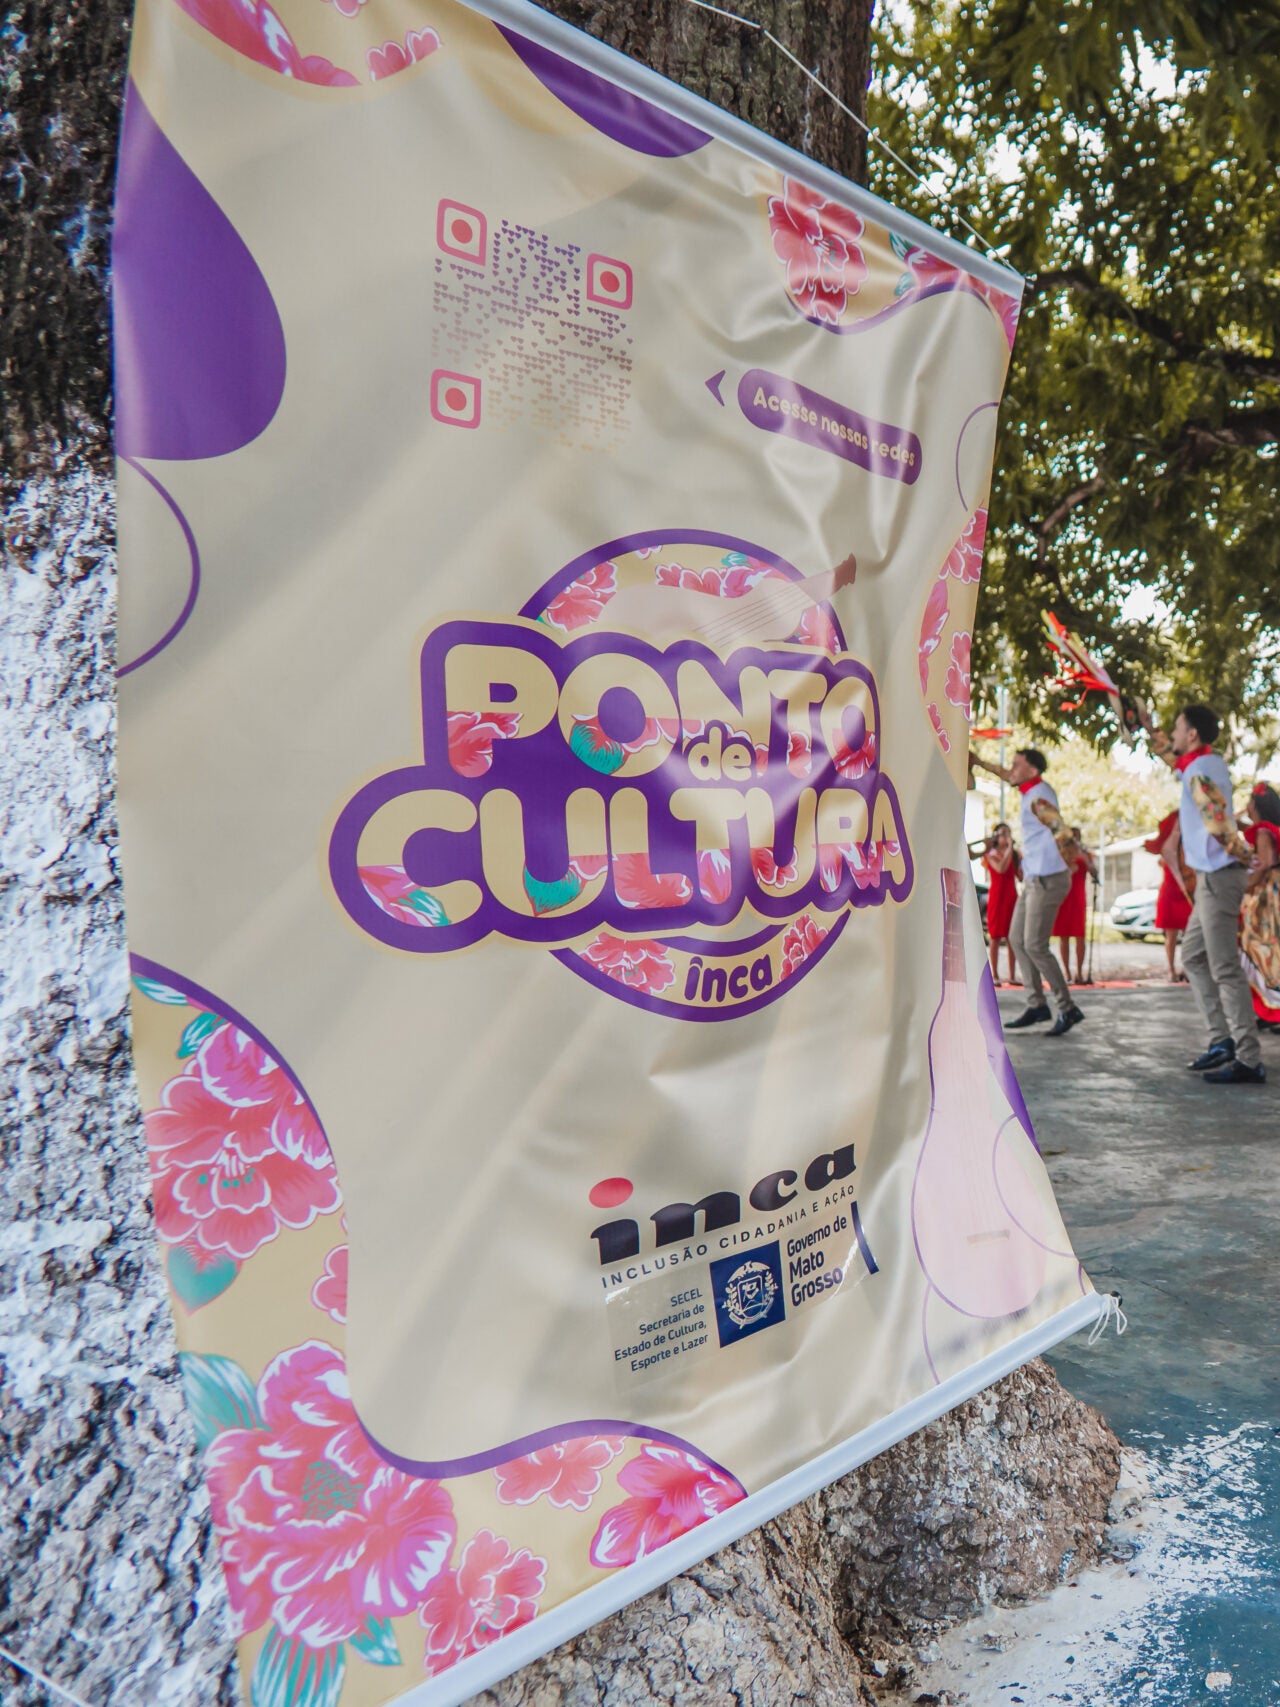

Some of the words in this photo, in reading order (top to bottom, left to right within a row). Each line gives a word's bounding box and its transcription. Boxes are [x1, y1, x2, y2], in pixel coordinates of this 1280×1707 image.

[753, 387, 818, 426] Acesse
[821, 415, 868, 451] nossas
[870, 441, 915, 467] redes
[444, 643, 878, 780] PONTO
[687, 726, 753, 781] de
[356, 786, 908, 928] CULTURA
[588, 1143, 857, 1266] inca
[601, 1244, 708, 1289] INCLUSÃO
[719, 1207, 807, 1249] CIDADANIA
[812, 1201, 819, 1213] E
[825, 1184, 855, 1208] AÇÃO
[786, 1224, 831, 1258] Governo
[833, 1214, 848, 1234] de
[789, 1249, 825, 1283] Mato
[791, 1266, 843, 1307] Grosso
[639, 1308, 691, 1335] Secretaria
[692, 1303, 705, 1315] de
[670, 1287, 703, 1307] SECEL
[614, 1340, 651, 1361] Estado
[653, 1334, 666, 1346] de
[668, 1320, 707, 1340] Cultura,
[630, 1349, 671, 1371] Esporte
[673, 1346, 679, 1355] e
[681, 1334, 708, 1351] Lazer
